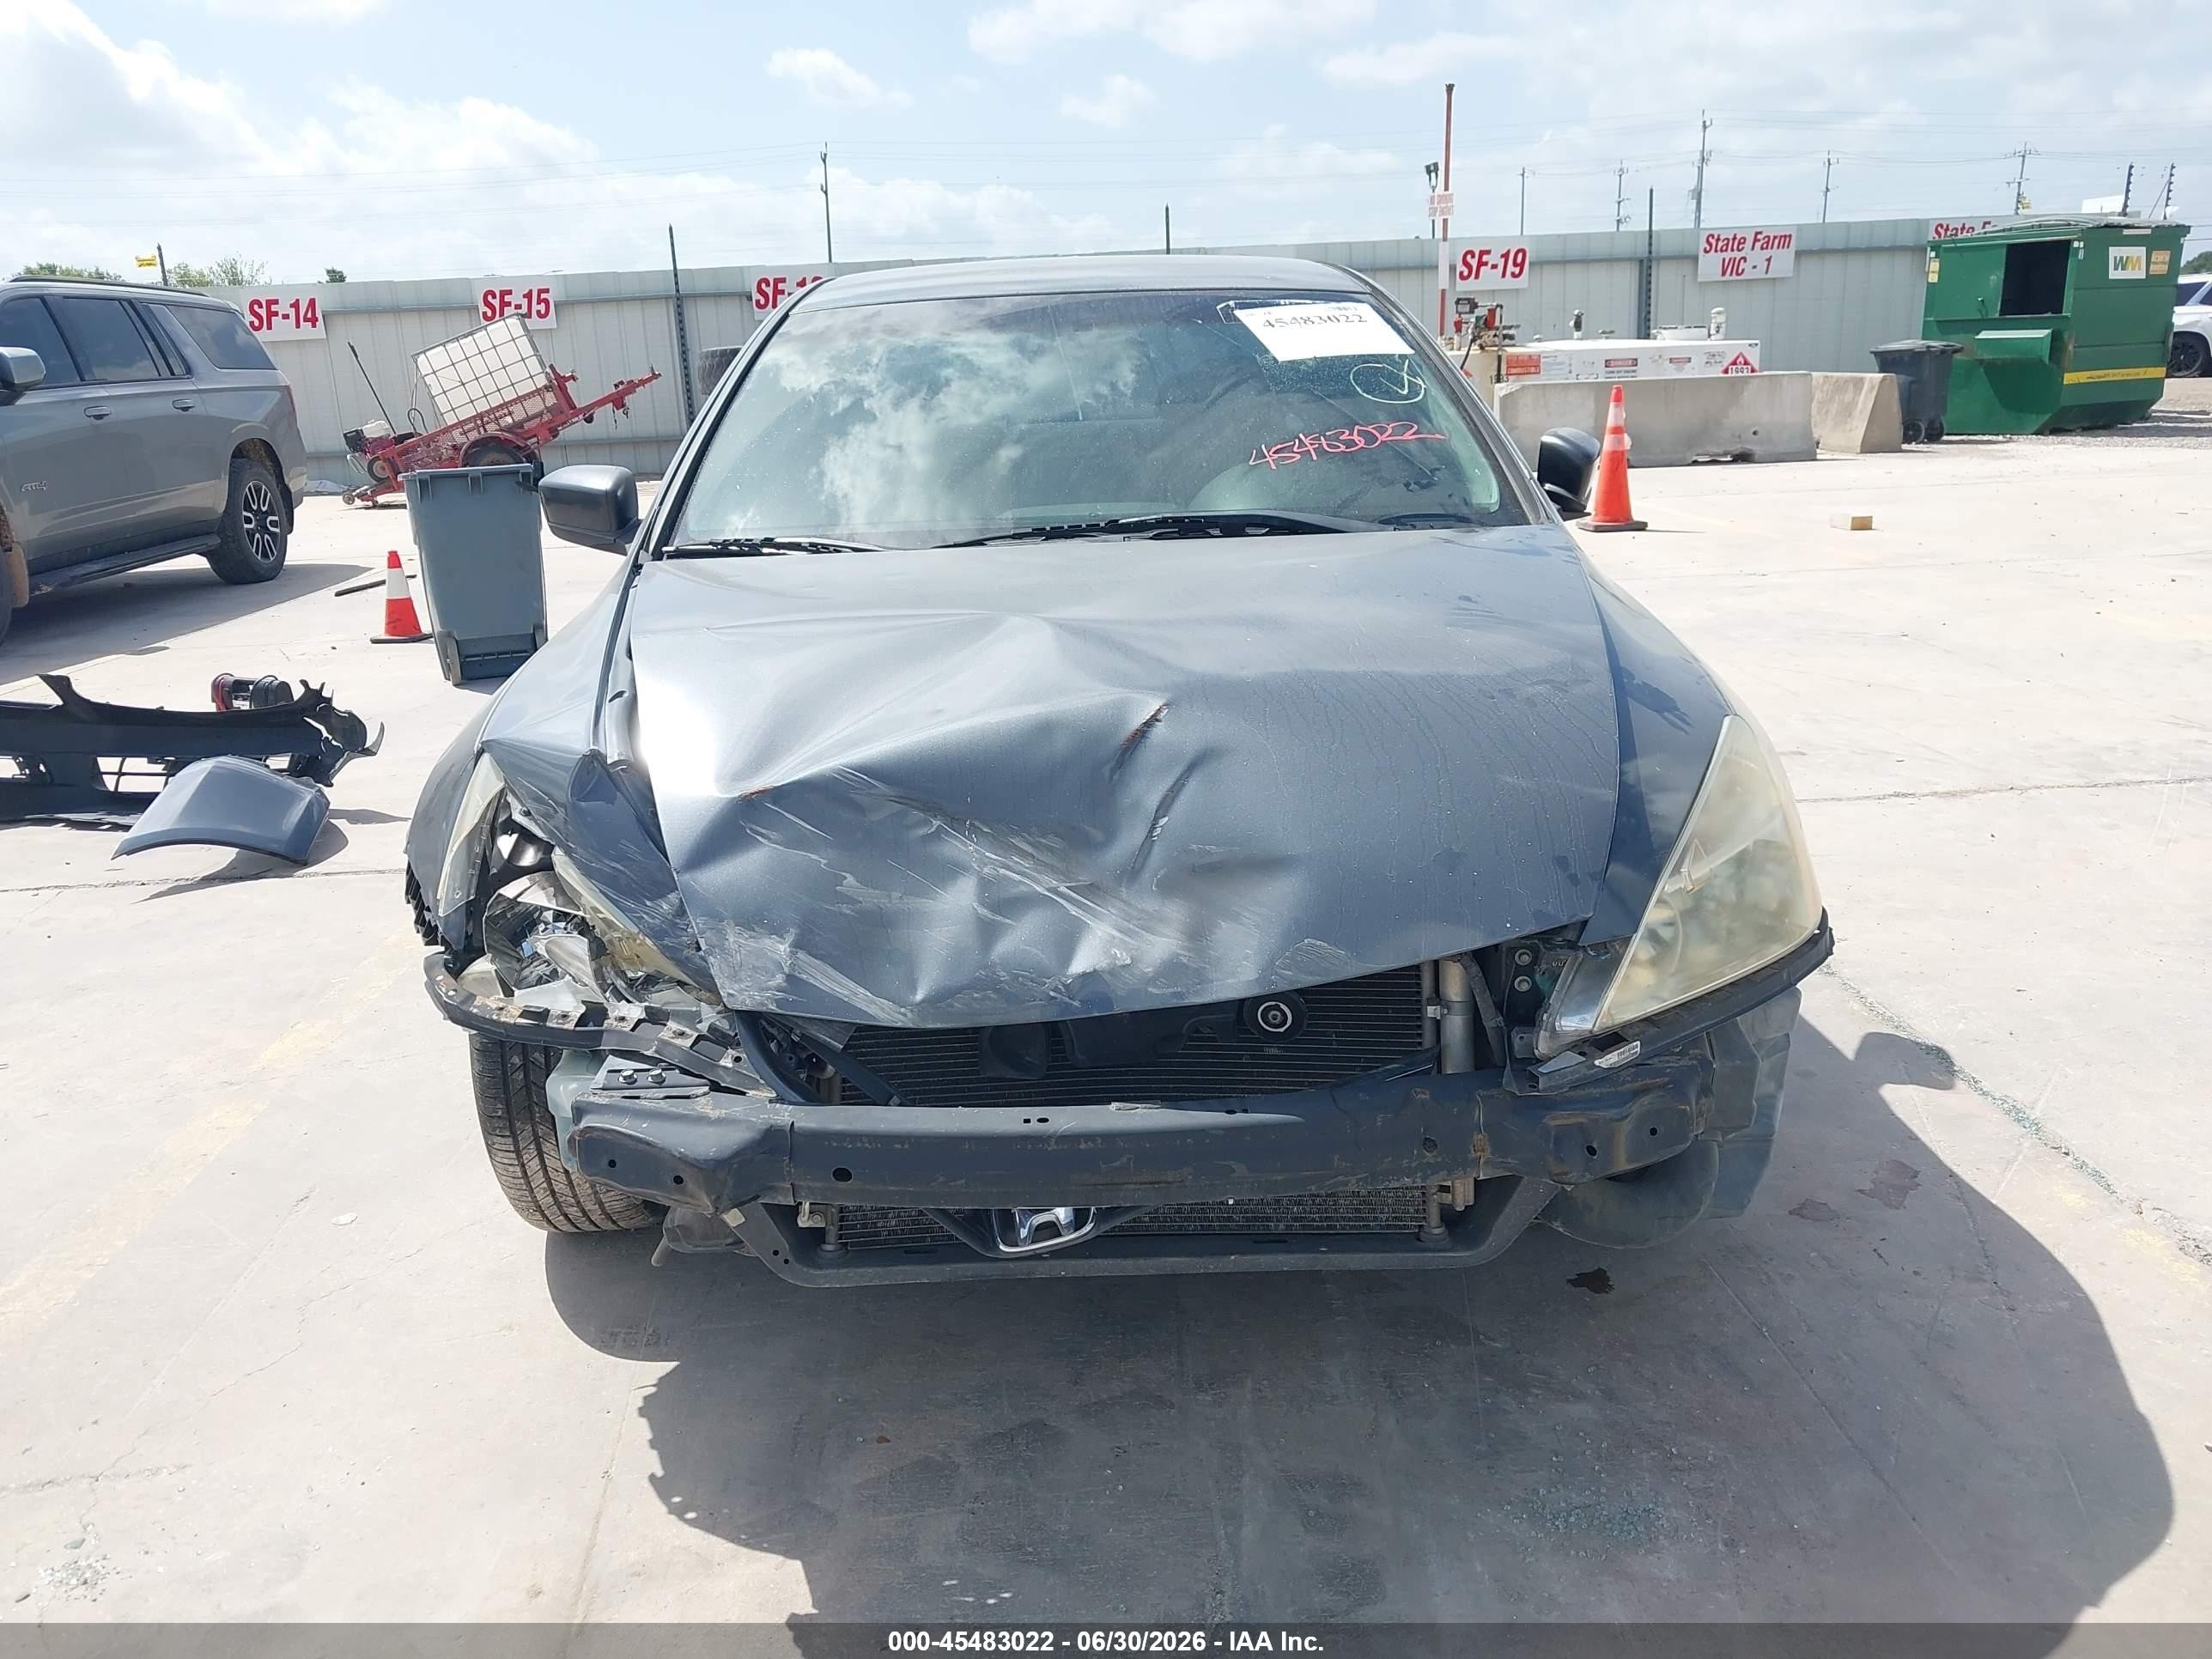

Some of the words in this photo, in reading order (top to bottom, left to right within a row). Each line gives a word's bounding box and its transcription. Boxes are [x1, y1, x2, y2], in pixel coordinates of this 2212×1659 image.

[1704, 233, 1747, 253] State
[1750, 230, 1792, 251] Farm
[1458, 247, 1528, 282] SF-19
[1720, 256, 1747, 276] VIC
[1765, 255, 1772, 275] 1
[248, 297, 319, 332] SF-14
[481, 287, 551, 322] SF-15
